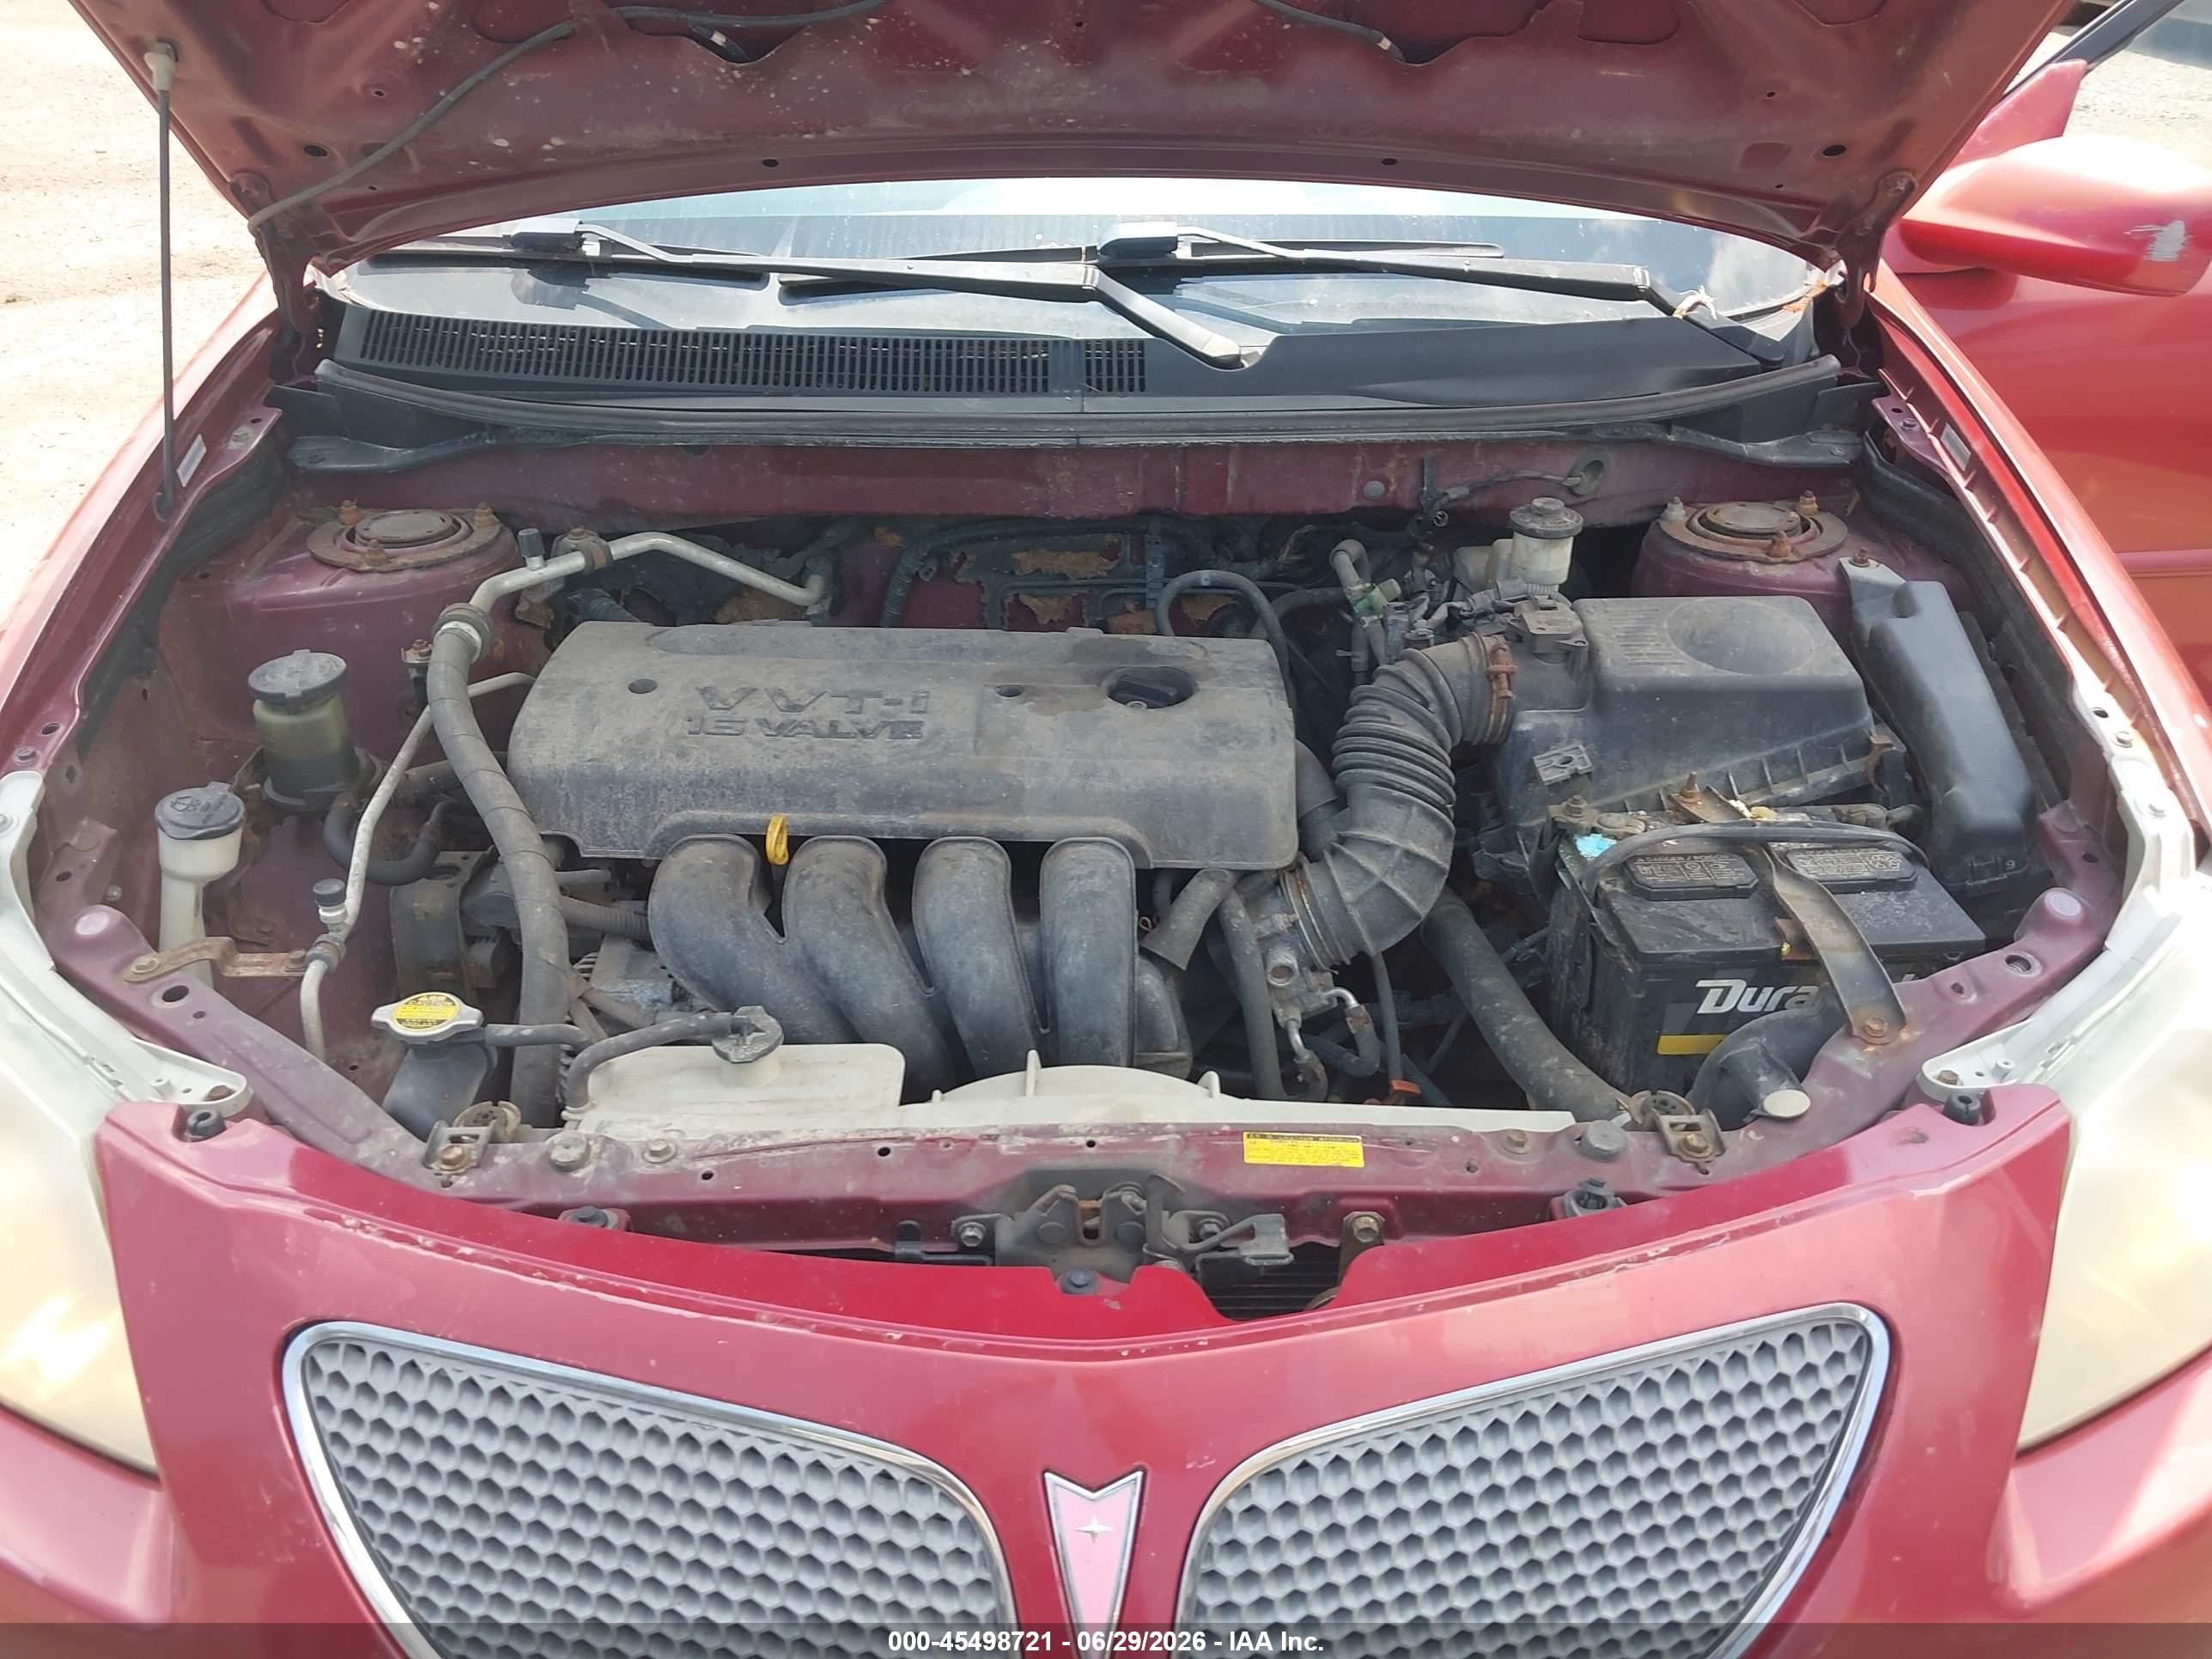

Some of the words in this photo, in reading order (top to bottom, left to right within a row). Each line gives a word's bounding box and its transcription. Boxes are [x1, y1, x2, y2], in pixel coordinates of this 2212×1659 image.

[687, 716, 746, 737] 16
[753, 718, 925, 740] VALVE
[1695, 979, 1824, 1014] Dura
